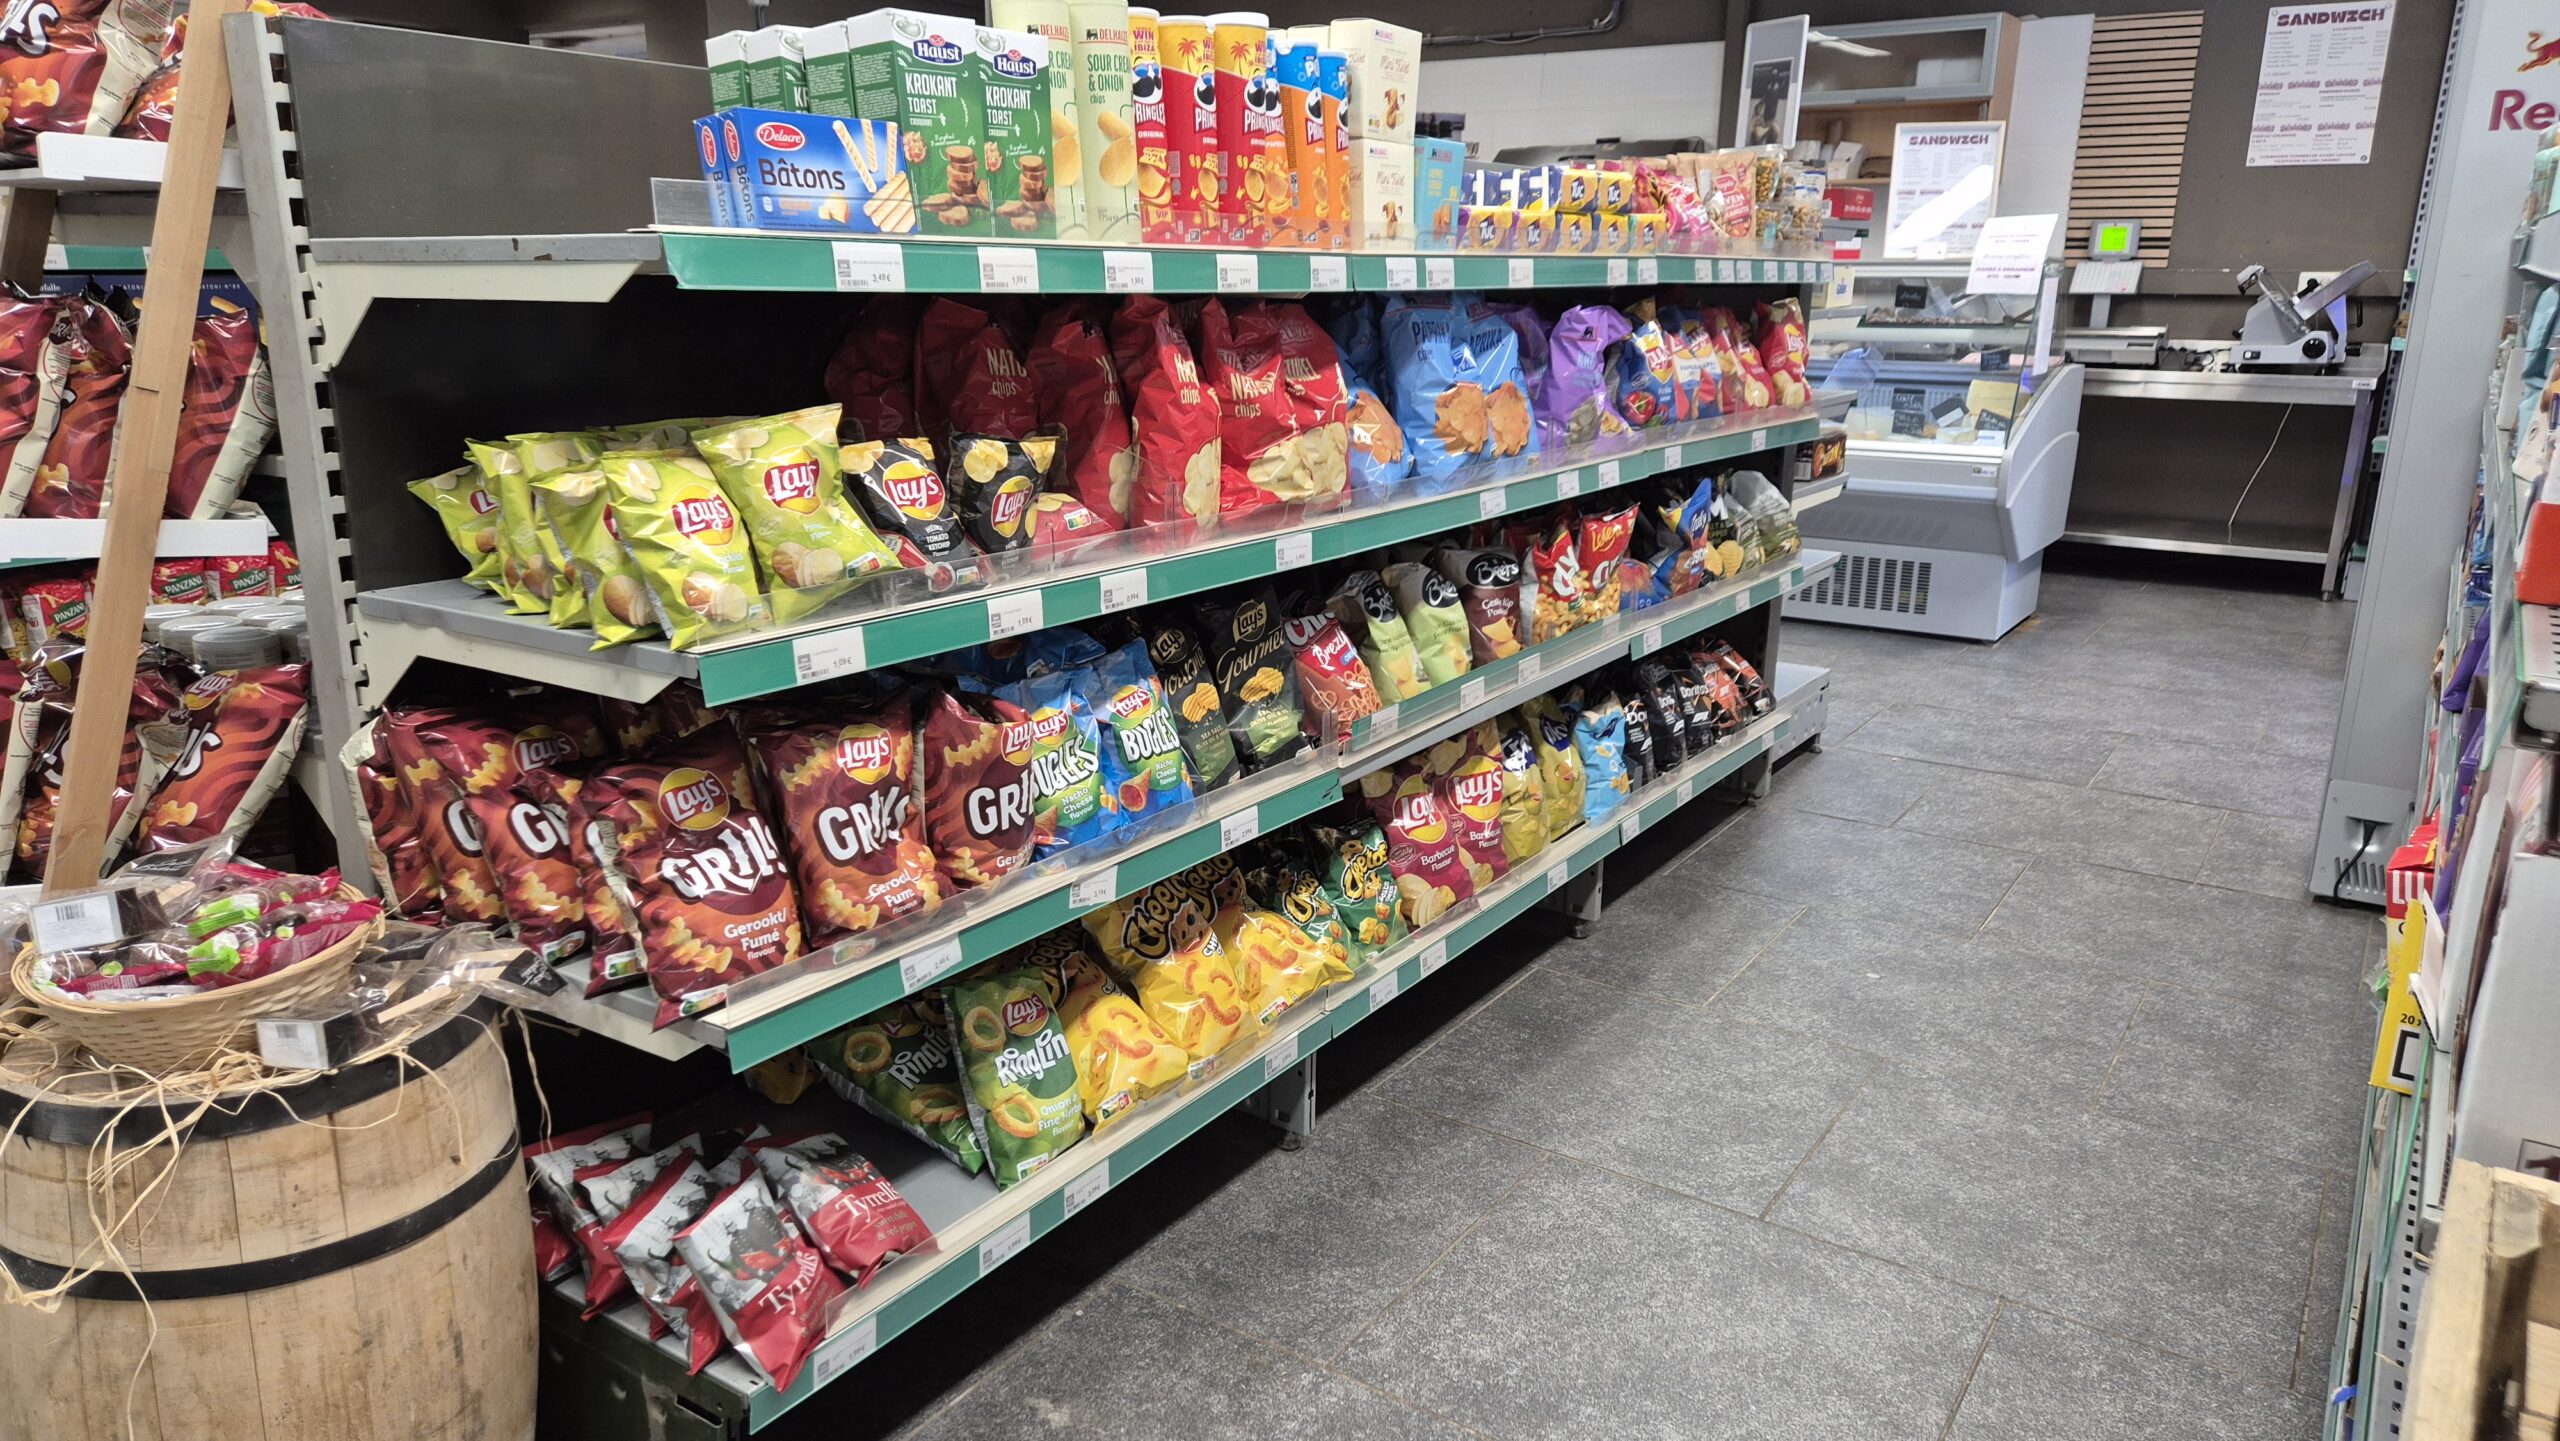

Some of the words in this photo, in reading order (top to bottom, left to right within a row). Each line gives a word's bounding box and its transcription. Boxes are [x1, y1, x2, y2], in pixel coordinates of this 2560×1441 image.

[2277, 8, 2386, 27] SANDWICH
[1133, 30, 1155, 41] WIN
[918, 41, 960, 61] Haust
[997, 56, 1035, 75] Haust
[1087, 54, 1112, 72] SOUR
[906, 72, 957, 98] KROKANT
[1088, 75, 1096, 91] &
[1097, 74, 1124, 92] ONION
[908, 96, 937, 114] TOAST
[986, 85, 1031, 110] KROKANT
[987, 110, 1013, 125] TOAST
[2488, 89, 2560, 131] Re
[760, 126, 802, 144] Delacre
[1909, 134, 1989, 146] SANDWICH
[758, 157, 846, 191] Bâtons
[737, 164, 754, 222] Bâtons
[991, 379, 1018, 397] chips
[1180, 386, 1201, 405] chips
[1234, 403, 1261, 418] chips
[766, 459, 819, 503] Lay's
[888, 472, 942, 508] Lay's
[674, 495, 730, 535] Lay's
[925, 524, 943, 533] HEINZ
[926, 532, 949, 543] TOMATO
[164, 576, 203, 596] PANZANI
[233, 570, 267, 590] PANZANI
[53, 602, 86, 623] PANZANI
[1235, 606, 1266, 635] Lay's
[1117, 686, 1152, 715] Lay's
[1033, 713, 1069, 740] Lay's
[1119, 707, 1180, 763] BUGLES
[838, 734, 891, 770] Lay's
[1155, 758, 1174, 770] Nacho
[1155, 768, 1177, 779] Cheese
[664, 777, 722, 822] Lay's
[1061, 787, 1089, 806] Nacho
[1062, 795, 1094, 813] Cheese
[1069, 804, 1095, 820] flavour
[1420, 844, 1456, 867] Barbecue
[741, 929, 780, 953] Fumé
[747, 945, 777, 961] flavour
[1006, 997, 1044, 1027] Lay's
[2400, 1013, 2415, 1025] 20
[1040, 1096, 1069, 1116] Onion
[1038, 1113, 1060, 1133] Fine
